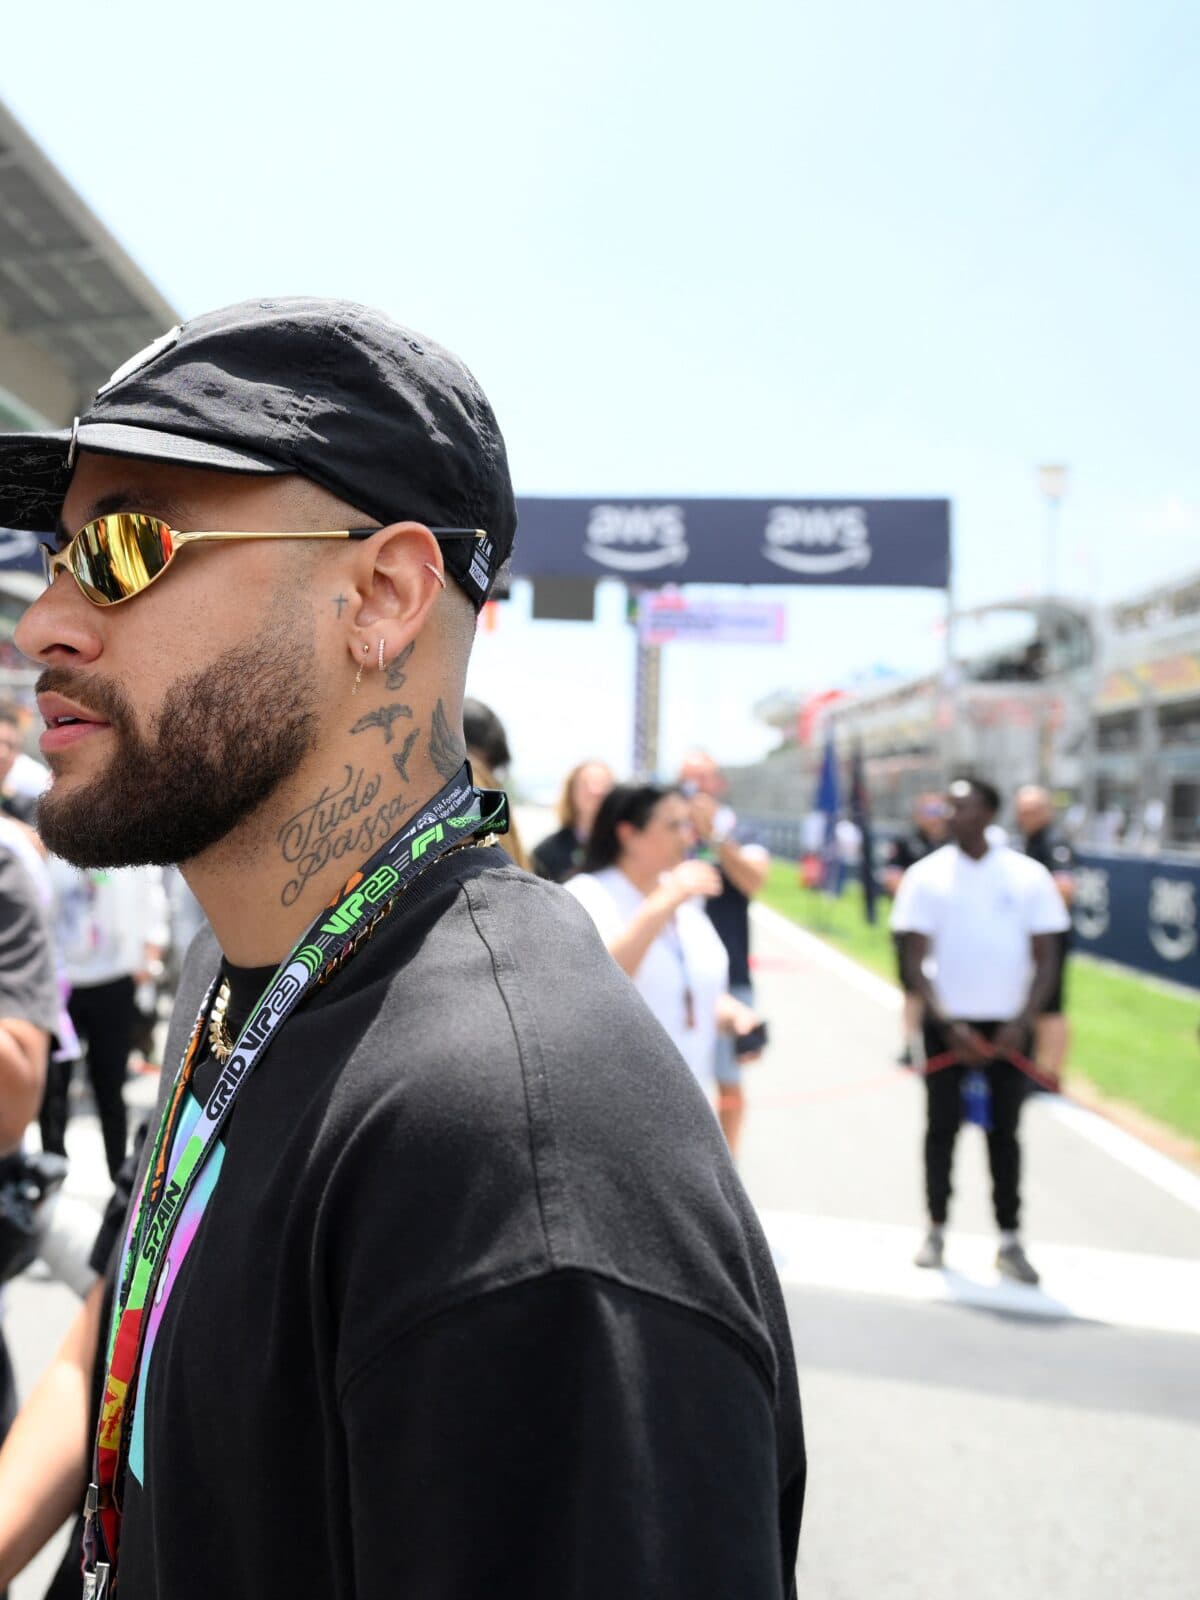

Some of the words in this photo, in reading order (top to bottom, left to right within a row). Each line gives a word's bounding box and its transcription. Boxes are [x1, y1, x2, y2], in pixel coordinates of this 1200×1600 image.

[587, 505, 685, 545] aws
[765, 506, 867, 547] aws
[277, 765, 381, 862] Tudo
[320, 865, 400, 935] VIP23
[205, 1054, 247, 1122] GRID
[245, 974, 301, 1052] VIP23
[142, 1180, 182, 1266] SPAIN
